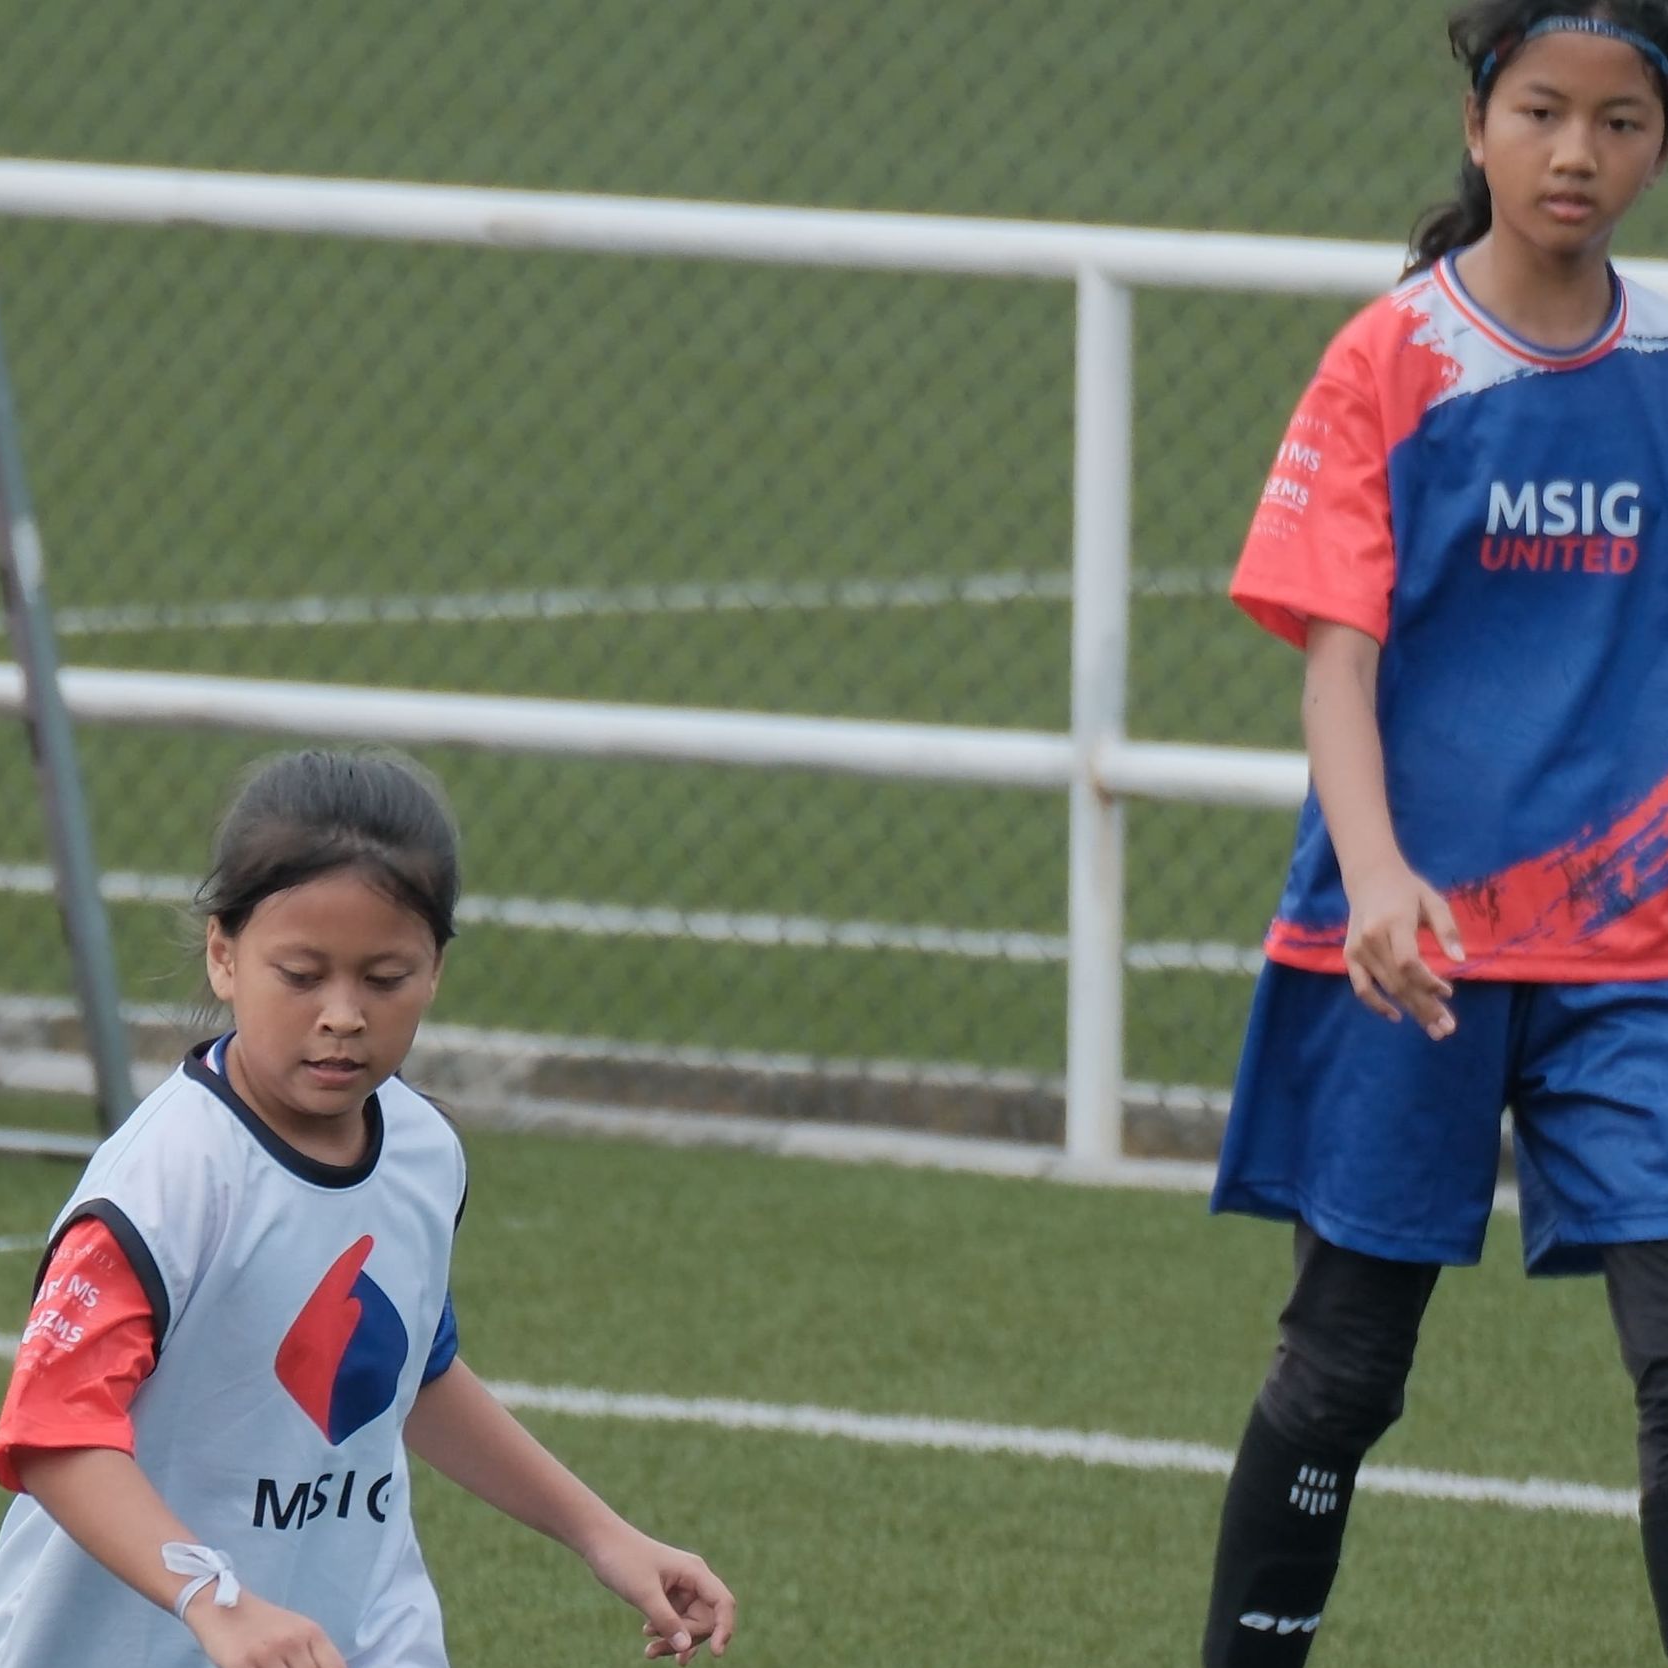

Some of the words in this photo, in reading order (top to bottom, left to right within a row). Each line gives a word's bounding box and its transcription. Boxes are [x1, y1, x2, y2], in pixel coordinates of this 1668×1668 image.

[1485, 481, 1641, 538] MSIG
[1480, 535, 1640, 575] UNITED
[66, 1273, 101, 1308] MS
